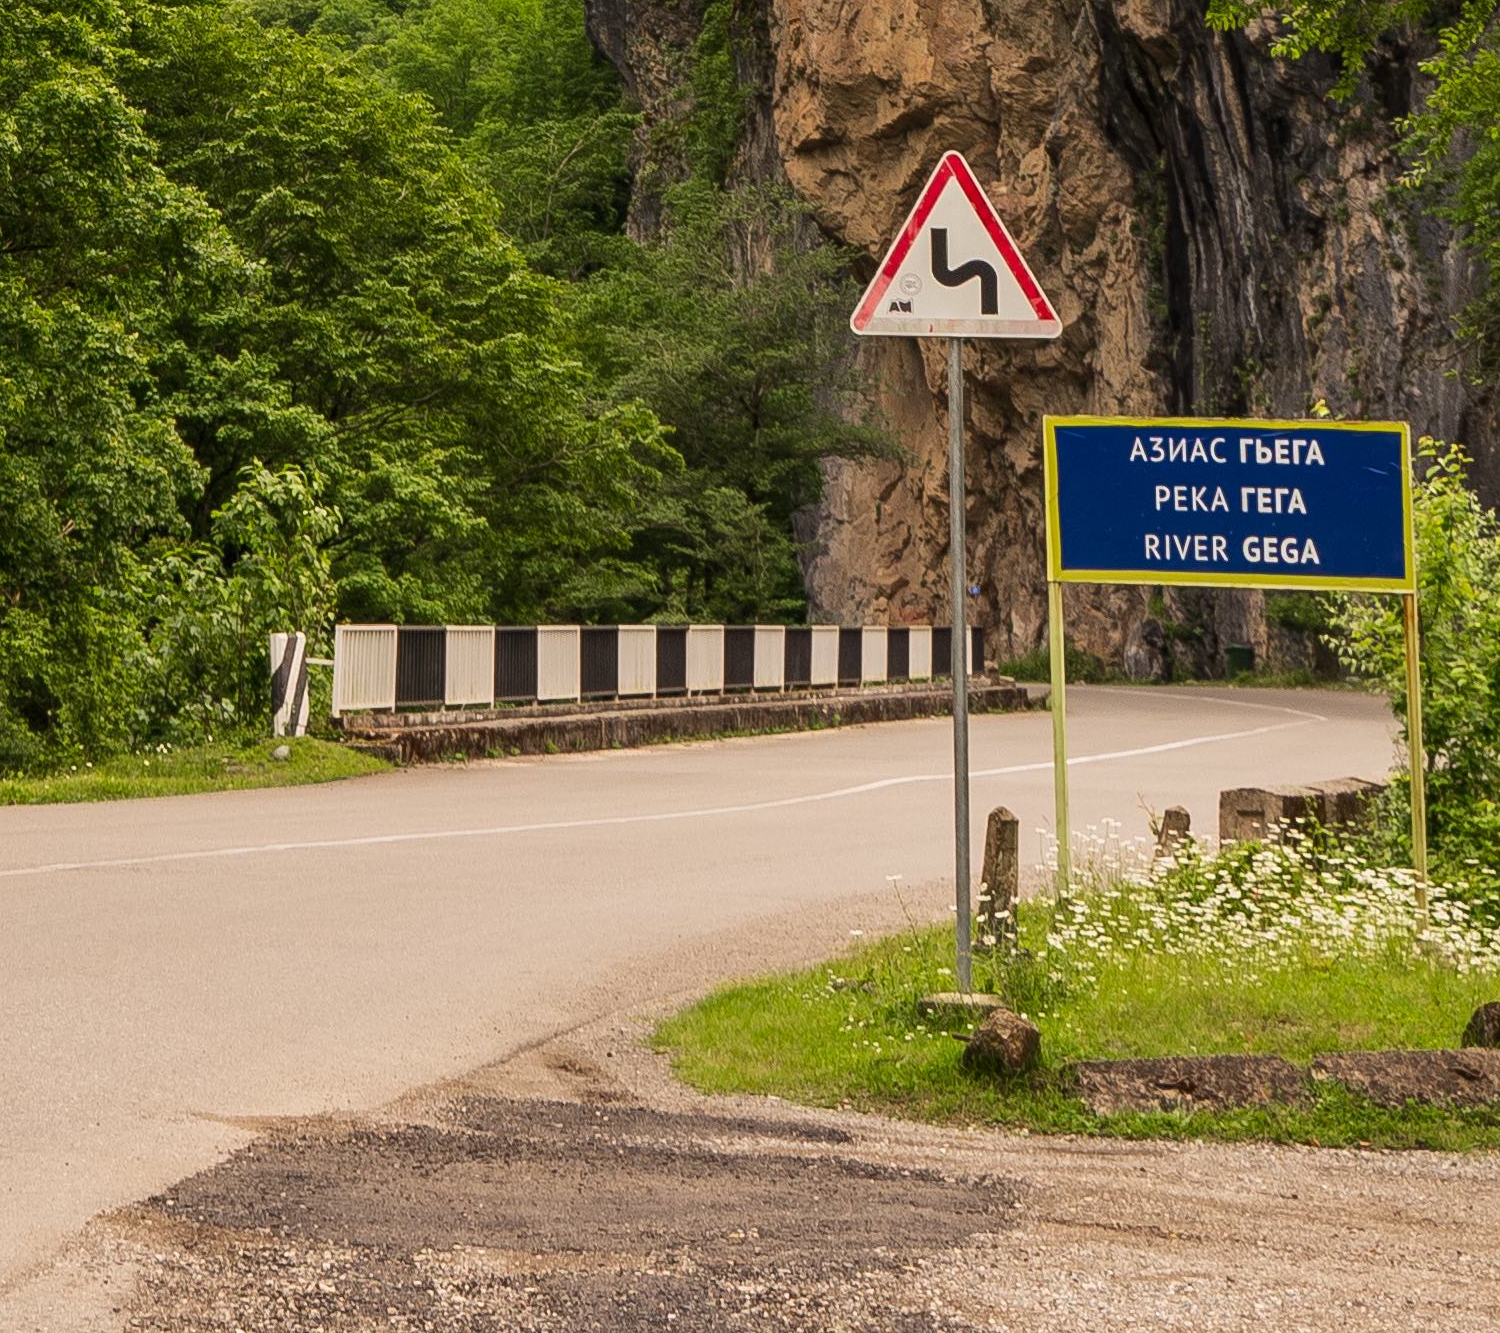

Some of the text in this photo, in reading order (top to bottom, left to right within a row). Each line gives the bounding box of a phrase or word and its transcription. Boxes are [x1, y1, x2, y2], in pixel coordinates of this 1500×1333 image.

[1239, 438, 1325, 466] ГЬЕГА
[1155, 485, 1307, 515] РЕКА ГЕГА
[1144, 534, 1320, 565] RIVER GEGA
